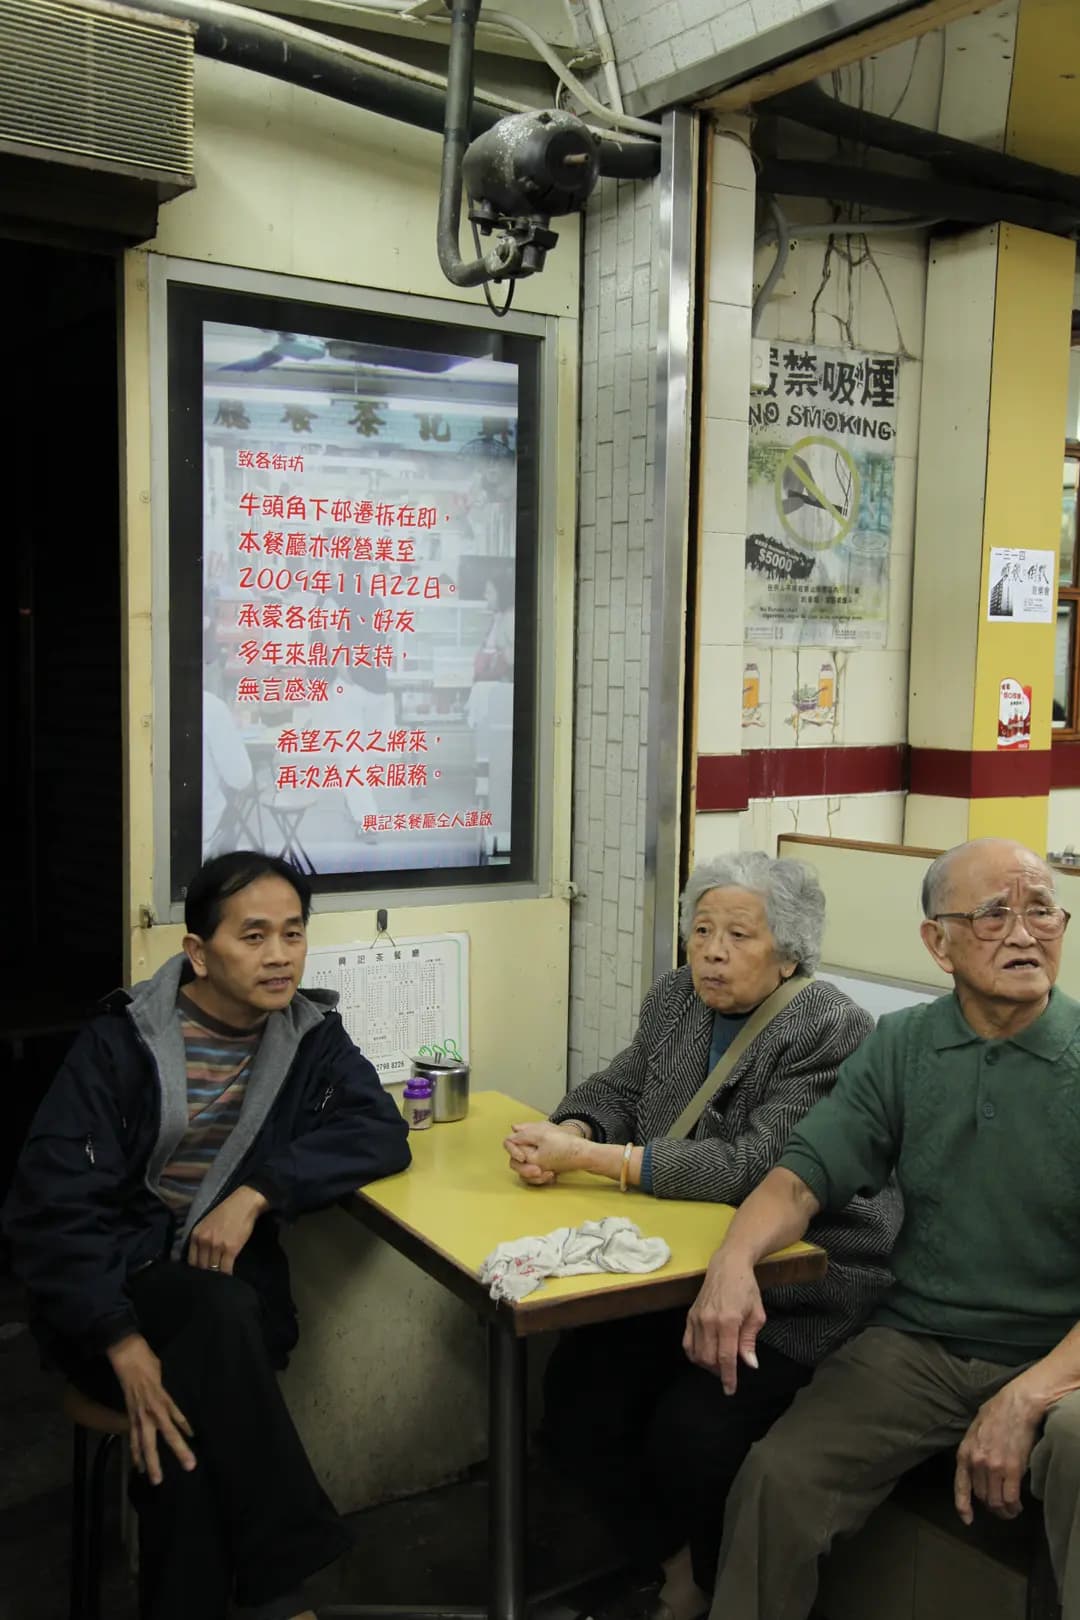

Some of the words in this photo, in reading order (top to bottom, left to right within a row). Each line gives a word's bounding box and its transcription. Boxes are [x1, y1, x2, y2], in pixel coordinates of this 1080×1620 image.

[749, 402, 780, 426] NO
[786, 405, 893, 441] SMOKING
[238, 450, 304, 471] 致各街坊
[238, 492, 452, 529] 牛頭角下邨遷拆在即，
[238, 530, 415, 563] 本餐廳亦將營業至
[758, 548, 793, 572] $5000
[238, 567, 457, 599] 2009年11月22日。
[238, 603, 415, 633] 承蒙各街坊、好友
[238, 639, 408, 668] 多年來鼎力支持，
[238, 677, 345, 702] 無言感激。
[277, 729, 443, 753] 希望不久之將來，
[277, 763, 443, 790] 再次為大家服務。
